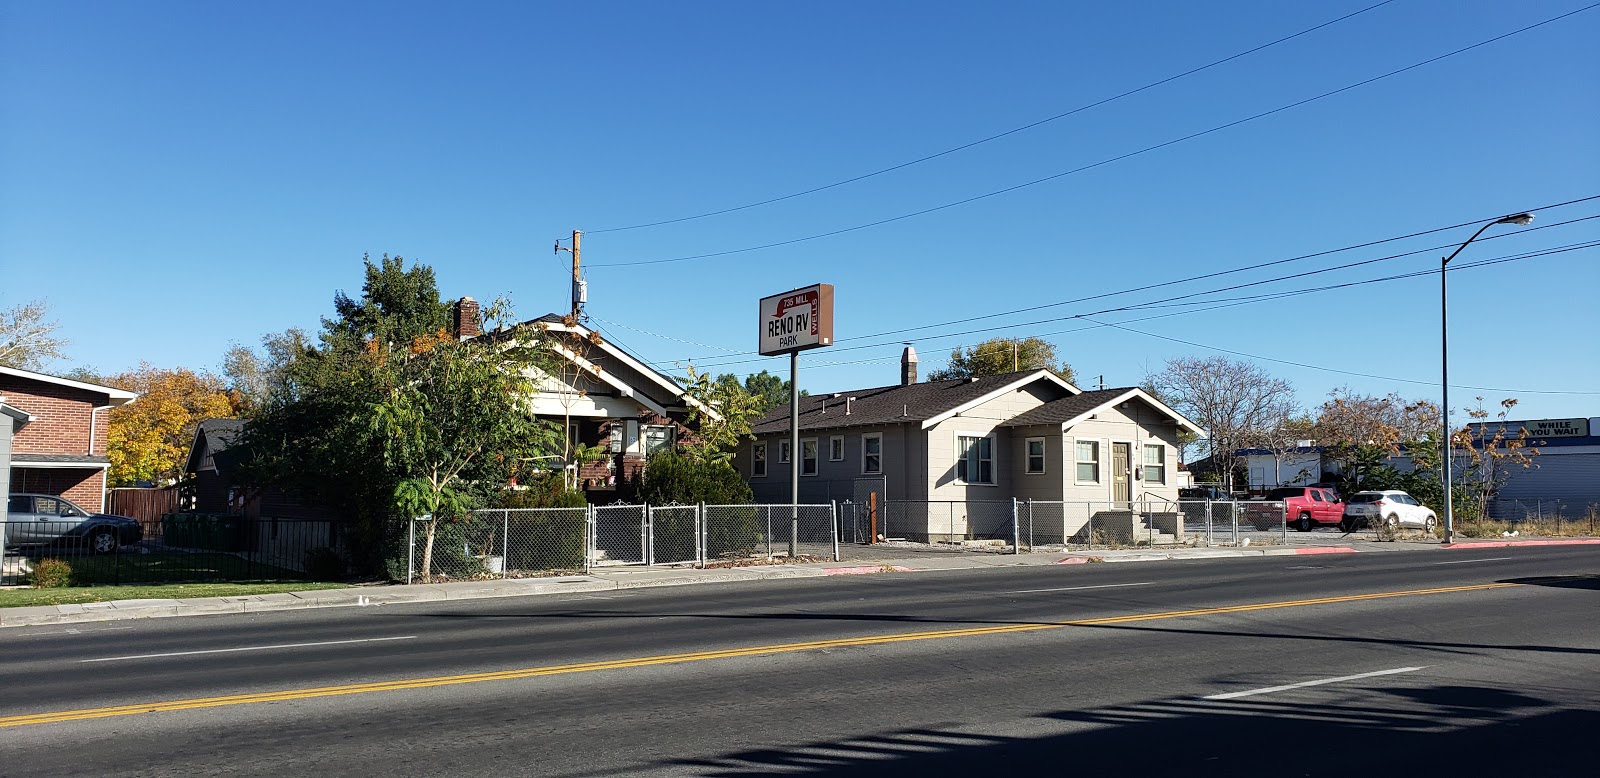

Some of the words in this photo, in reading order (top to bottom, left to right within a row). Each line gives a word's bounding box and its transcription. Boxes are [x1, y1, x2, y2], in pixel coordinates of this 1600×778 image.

[796, 294, 808, 304] MILL
[768, 316, 793, 338] RENO
[796, 313, 808, 332] RV
[780, 334, 798, 348] PARK
